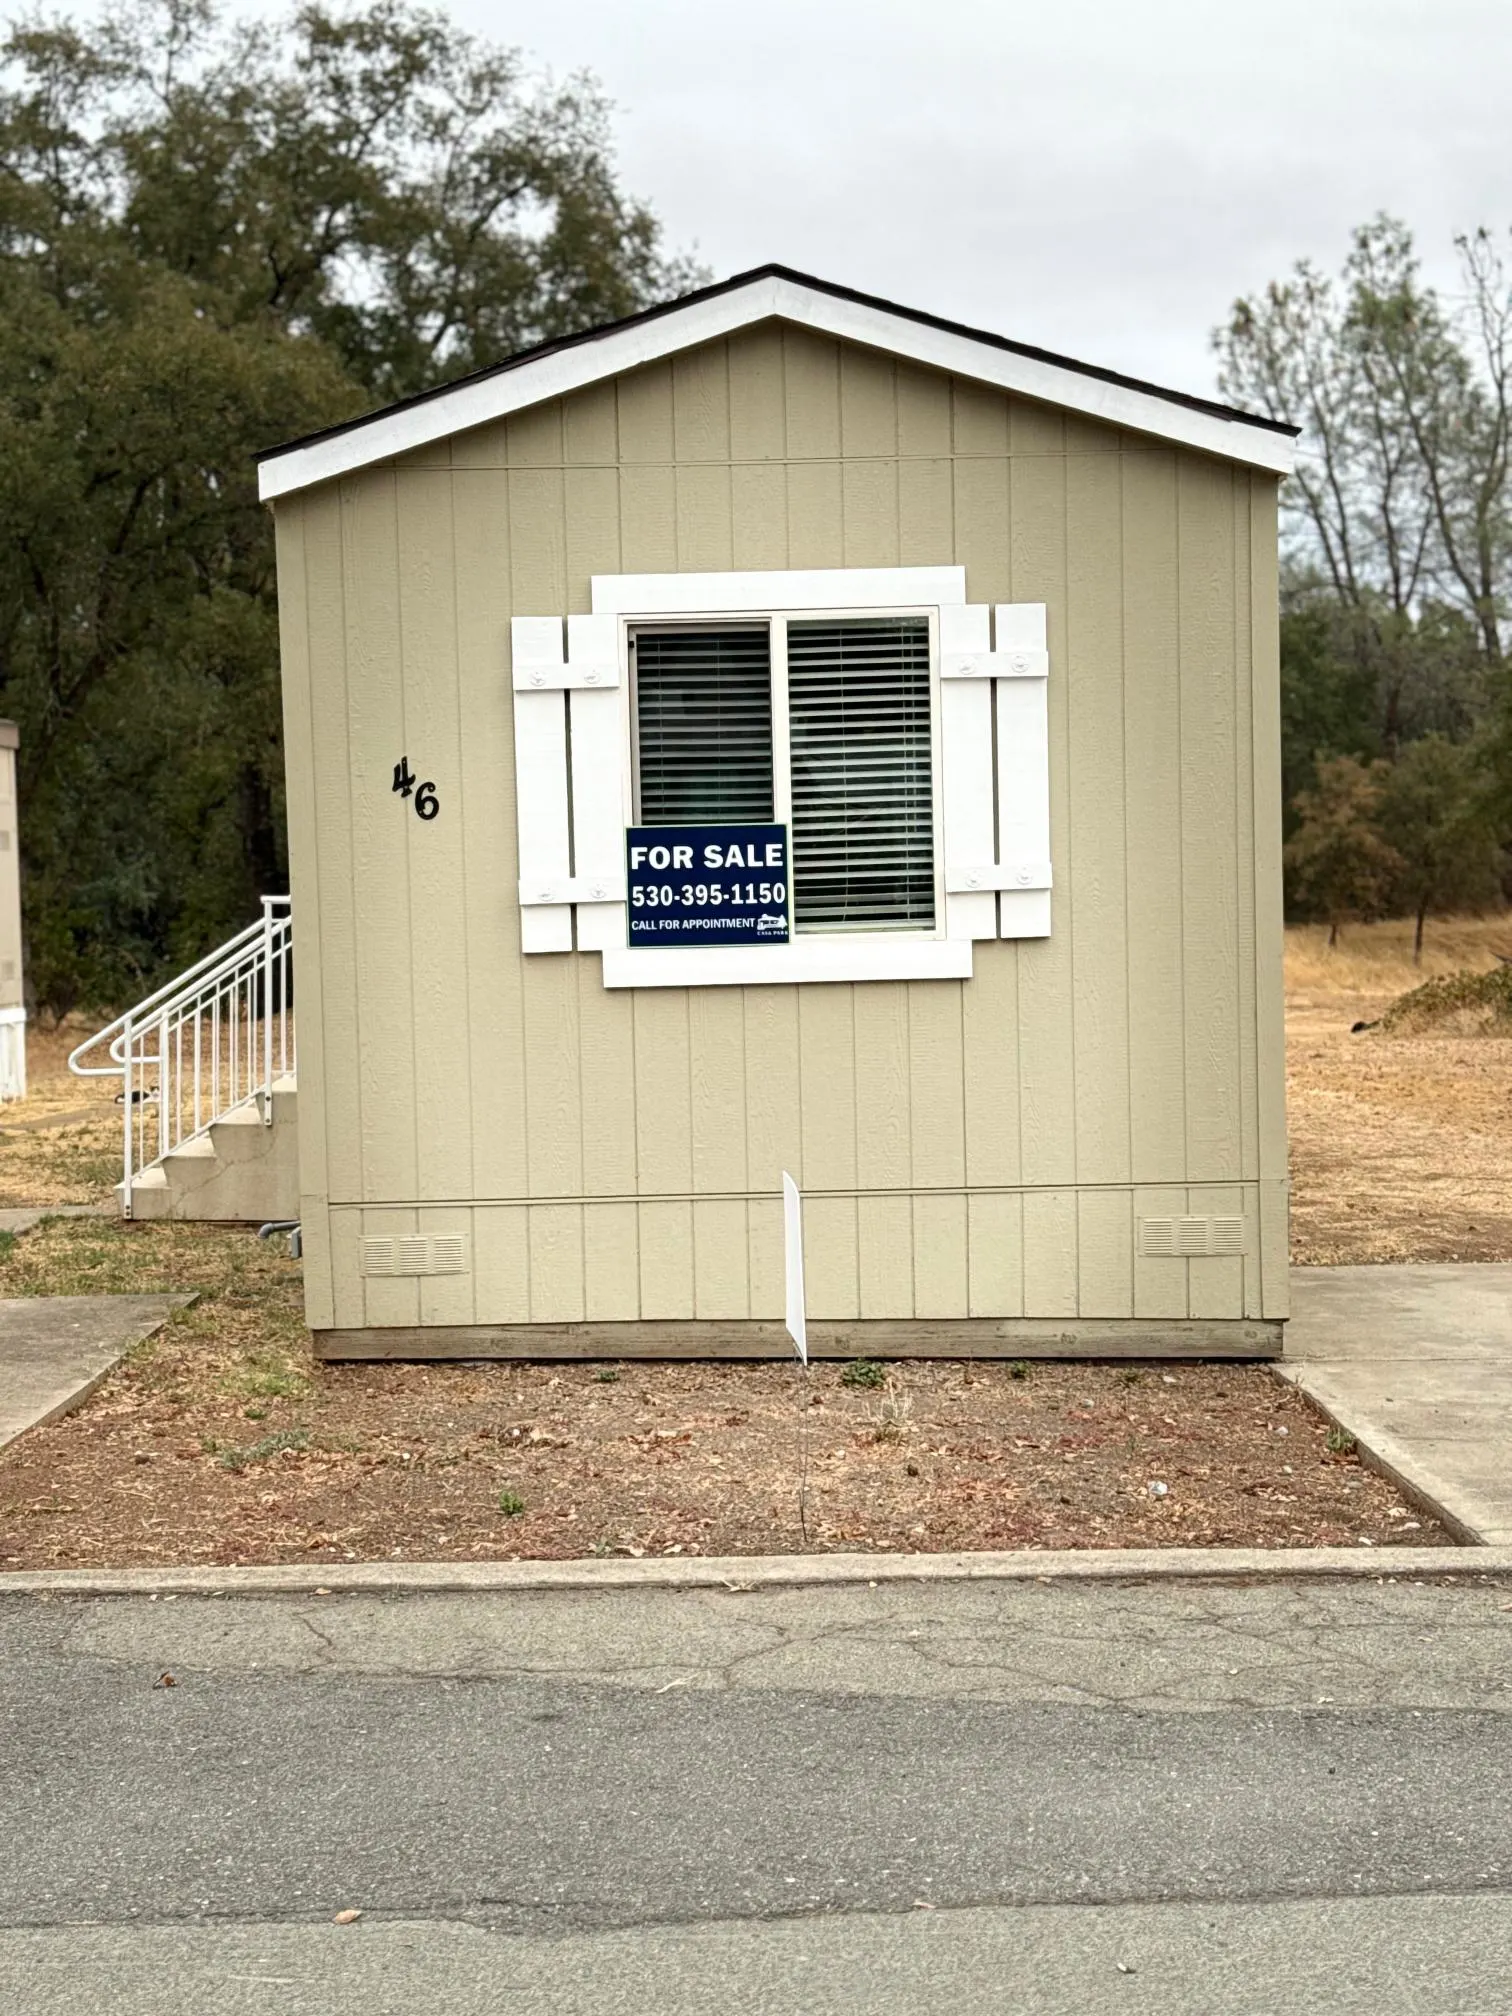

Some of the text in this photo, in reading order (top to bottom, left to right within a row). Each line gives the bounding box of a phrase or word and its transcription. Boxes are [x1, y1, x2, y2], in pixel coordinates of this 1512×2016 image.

[392, 755, 440, 820] 46
[630, 843, 784, 870] FOR SALE
[632, 882, 786, 907] 530-395-1150
[631, 917, 756, 931] CALL FOR APPOINTMENT
